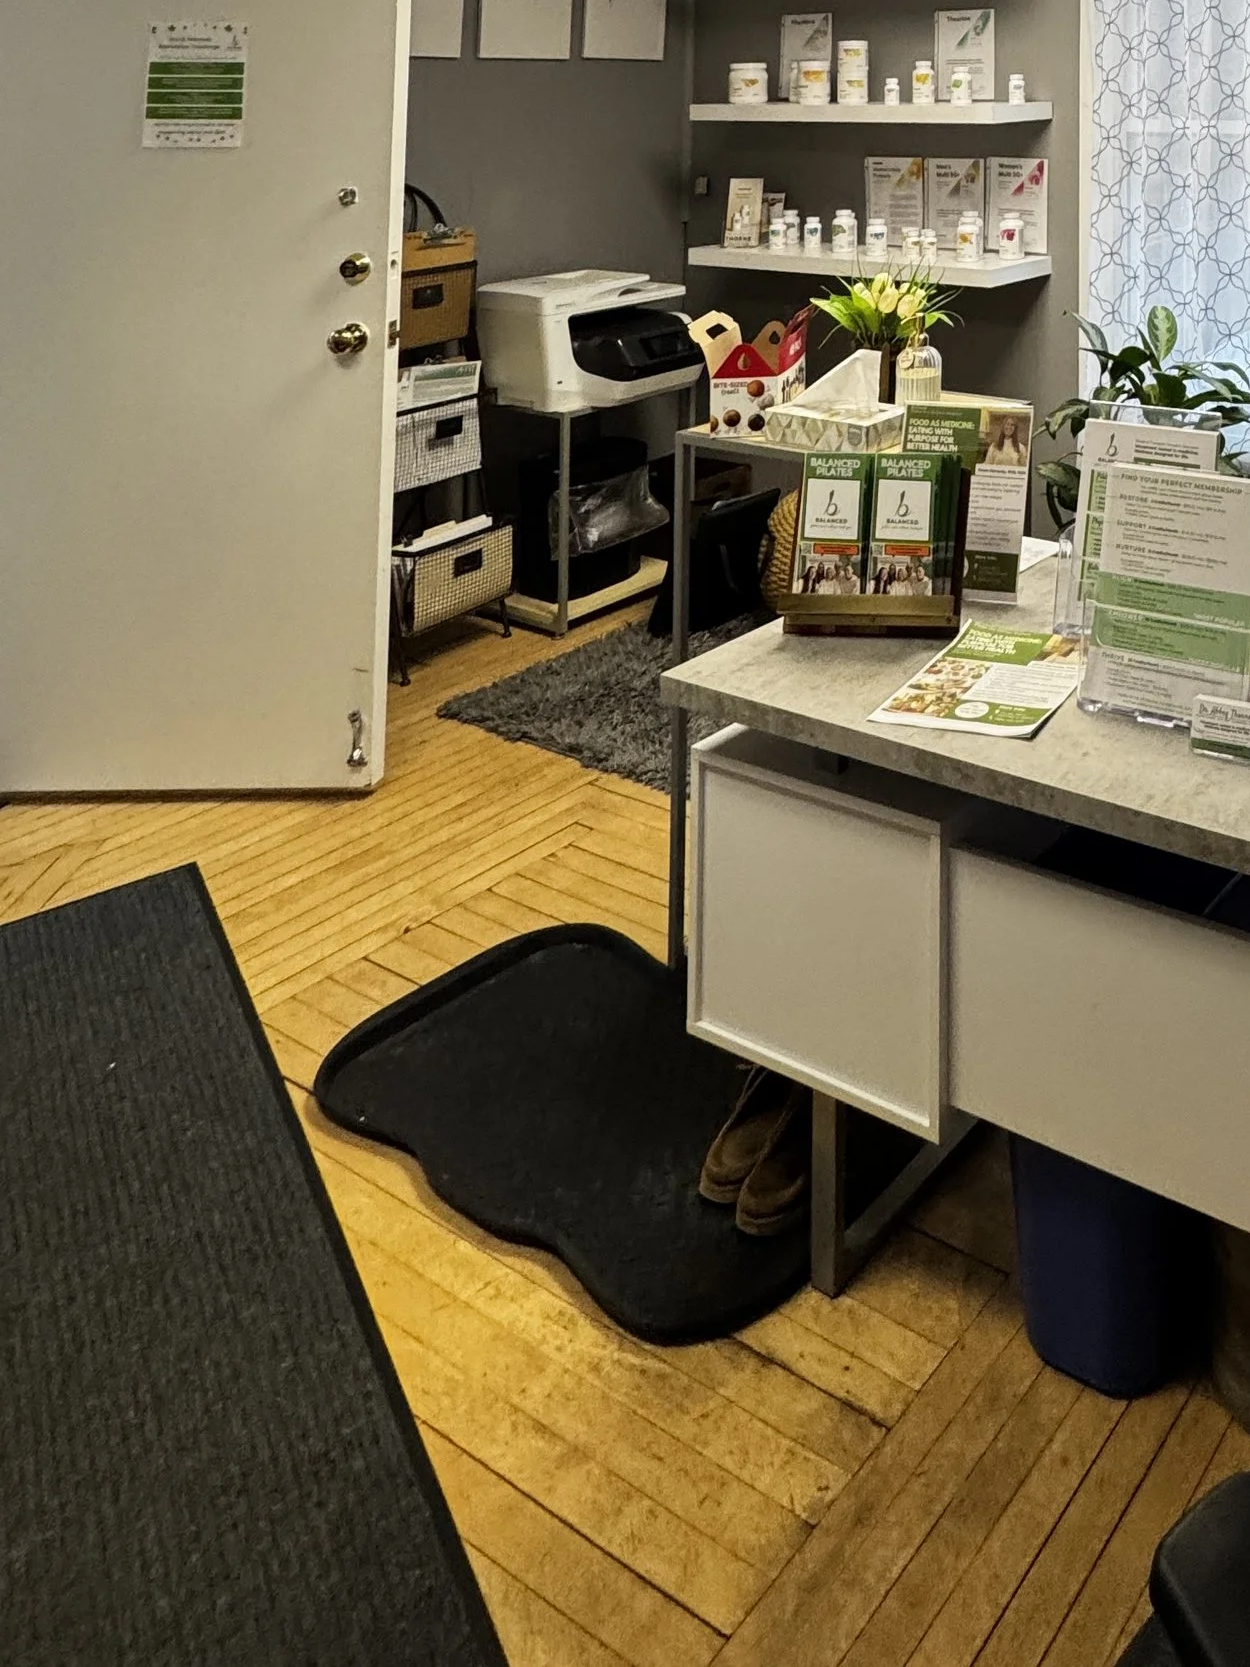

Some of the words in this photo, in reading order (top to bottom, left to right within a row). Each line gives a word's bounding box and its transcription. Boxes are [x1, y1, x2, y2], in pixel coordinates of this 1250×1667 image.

[909, 418, 929, 426] FOOD
[930, 419, 940, 427] AS
[908, 426, 934, 435] EATING
[935, 427, 953, 436] WITH
[907, 434, 939, 443] PURPOSE
[940, 435, 954, 444] FOR
[906, 441, 930, 451] BETTER
[931, 443, 958, 452] HEALTH
[810, 457, 861, 469] BALANCED
[881, 458, 932, 470] BALANCED
[816, 467, 853, 477] PILATES
[887, 468, 924, 478] PILATES
[1121, 473, 1138, 482] FIND
[1140, 475, 1159, 485] YOUR
[1161, 478, 1192, 489] PERFECT
[1194, 482, 1243, 495] MEMBERSHIP
[815, 517, 848, 525] BALANCED
[886, 518, 919, 526] BALANCED
[1117, 519, 1146, 530] SUPPORT
[1115, 542, 1146, 554] NURTURE
